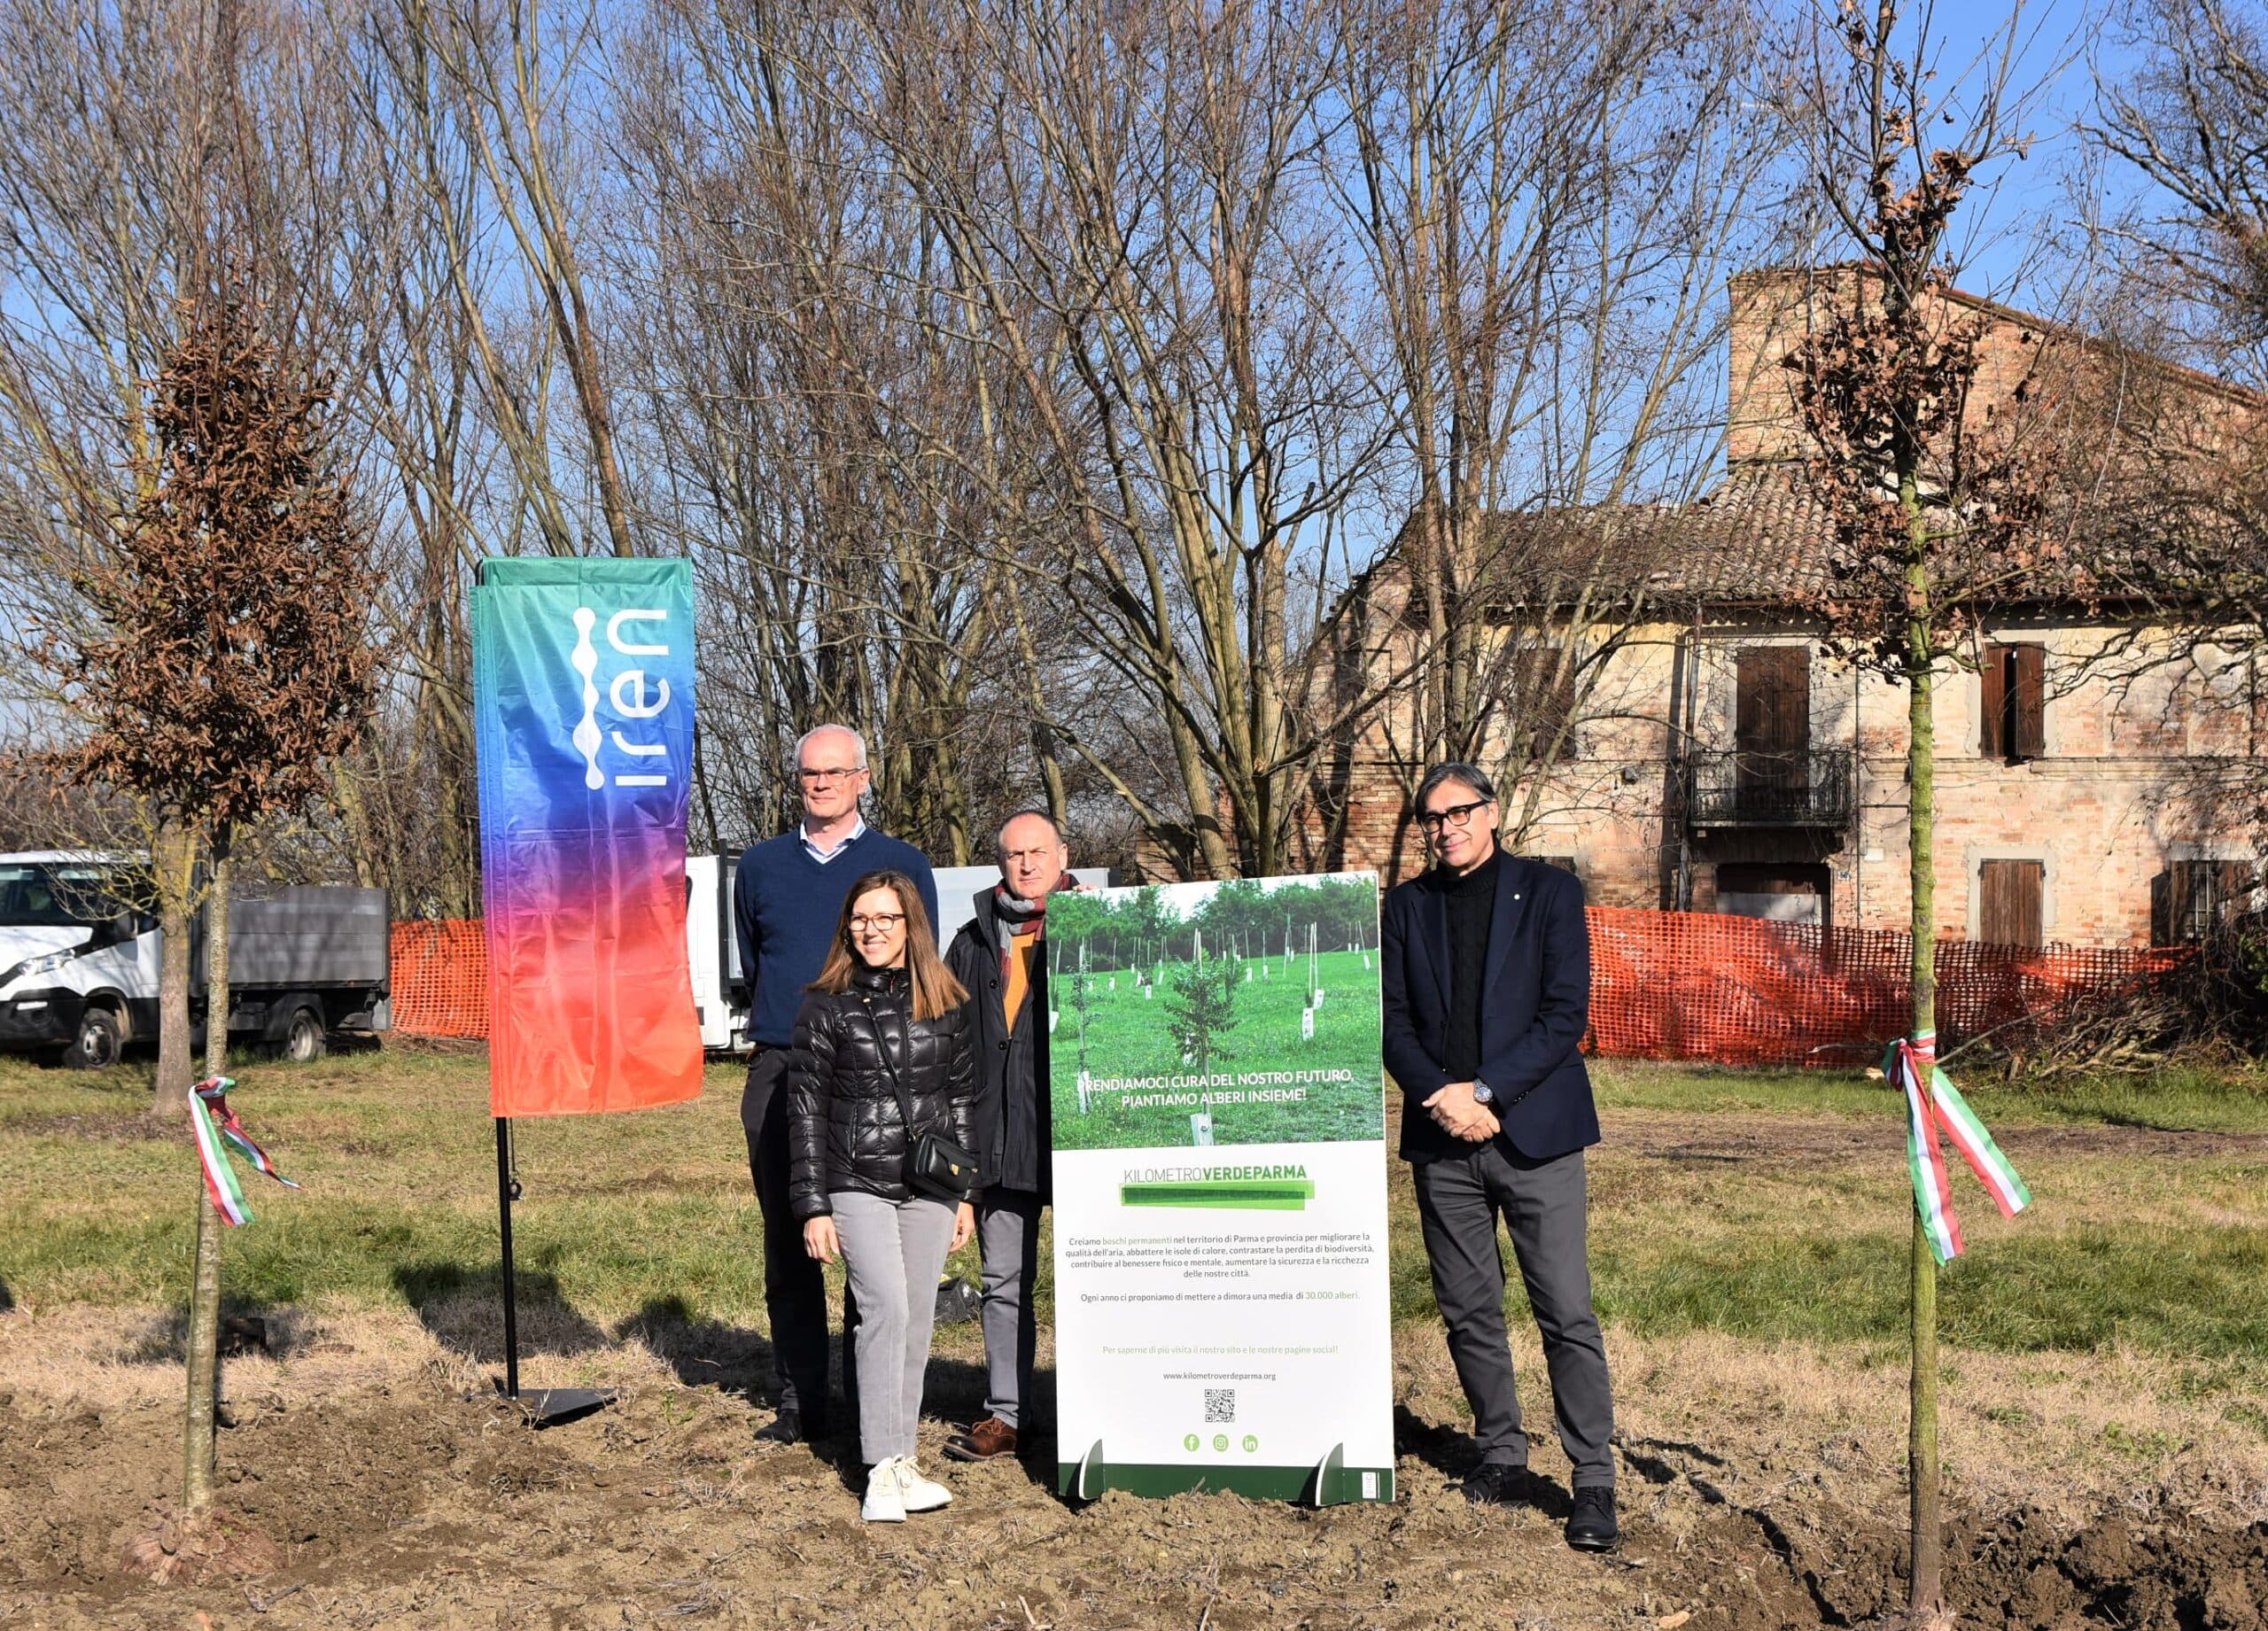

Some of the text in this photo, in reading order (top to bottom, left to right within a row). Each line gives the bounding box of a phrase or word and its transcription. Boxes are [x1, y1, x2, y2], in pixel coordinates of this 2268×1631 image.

[606, 609, 671, 787] iren
[1172, 1075, 1208, 1088] CURA
[1211, 1074, 1234, 1086] DEL
[1238, 1072, 1293, 1085] NOSTRO
[1296, 1069, 1354, 1083] FUTURO,
[1122, 1088, 1307, 1107] PIANTIAMO ALBERI INSIEME!
[1123, 1165, 1308, 1183] KILOMETROVERDEPARMA
[1129, 1237, 1172, 1246] permanenti
[1267, 1234, 1303, 1243] provincia
[1320, 1233, 1361, 1242] migliorare
[1066, 1249, 1091, 1258] qualità
[1285, 1245, 1313, 1254] perdita
[1081, 1294, 1099, 1303] Ogni
[1129, 1293, 1174, 1302] proponiamo
[1163, 1371, 1276, 1381] www.kilometroverdeparma.org
